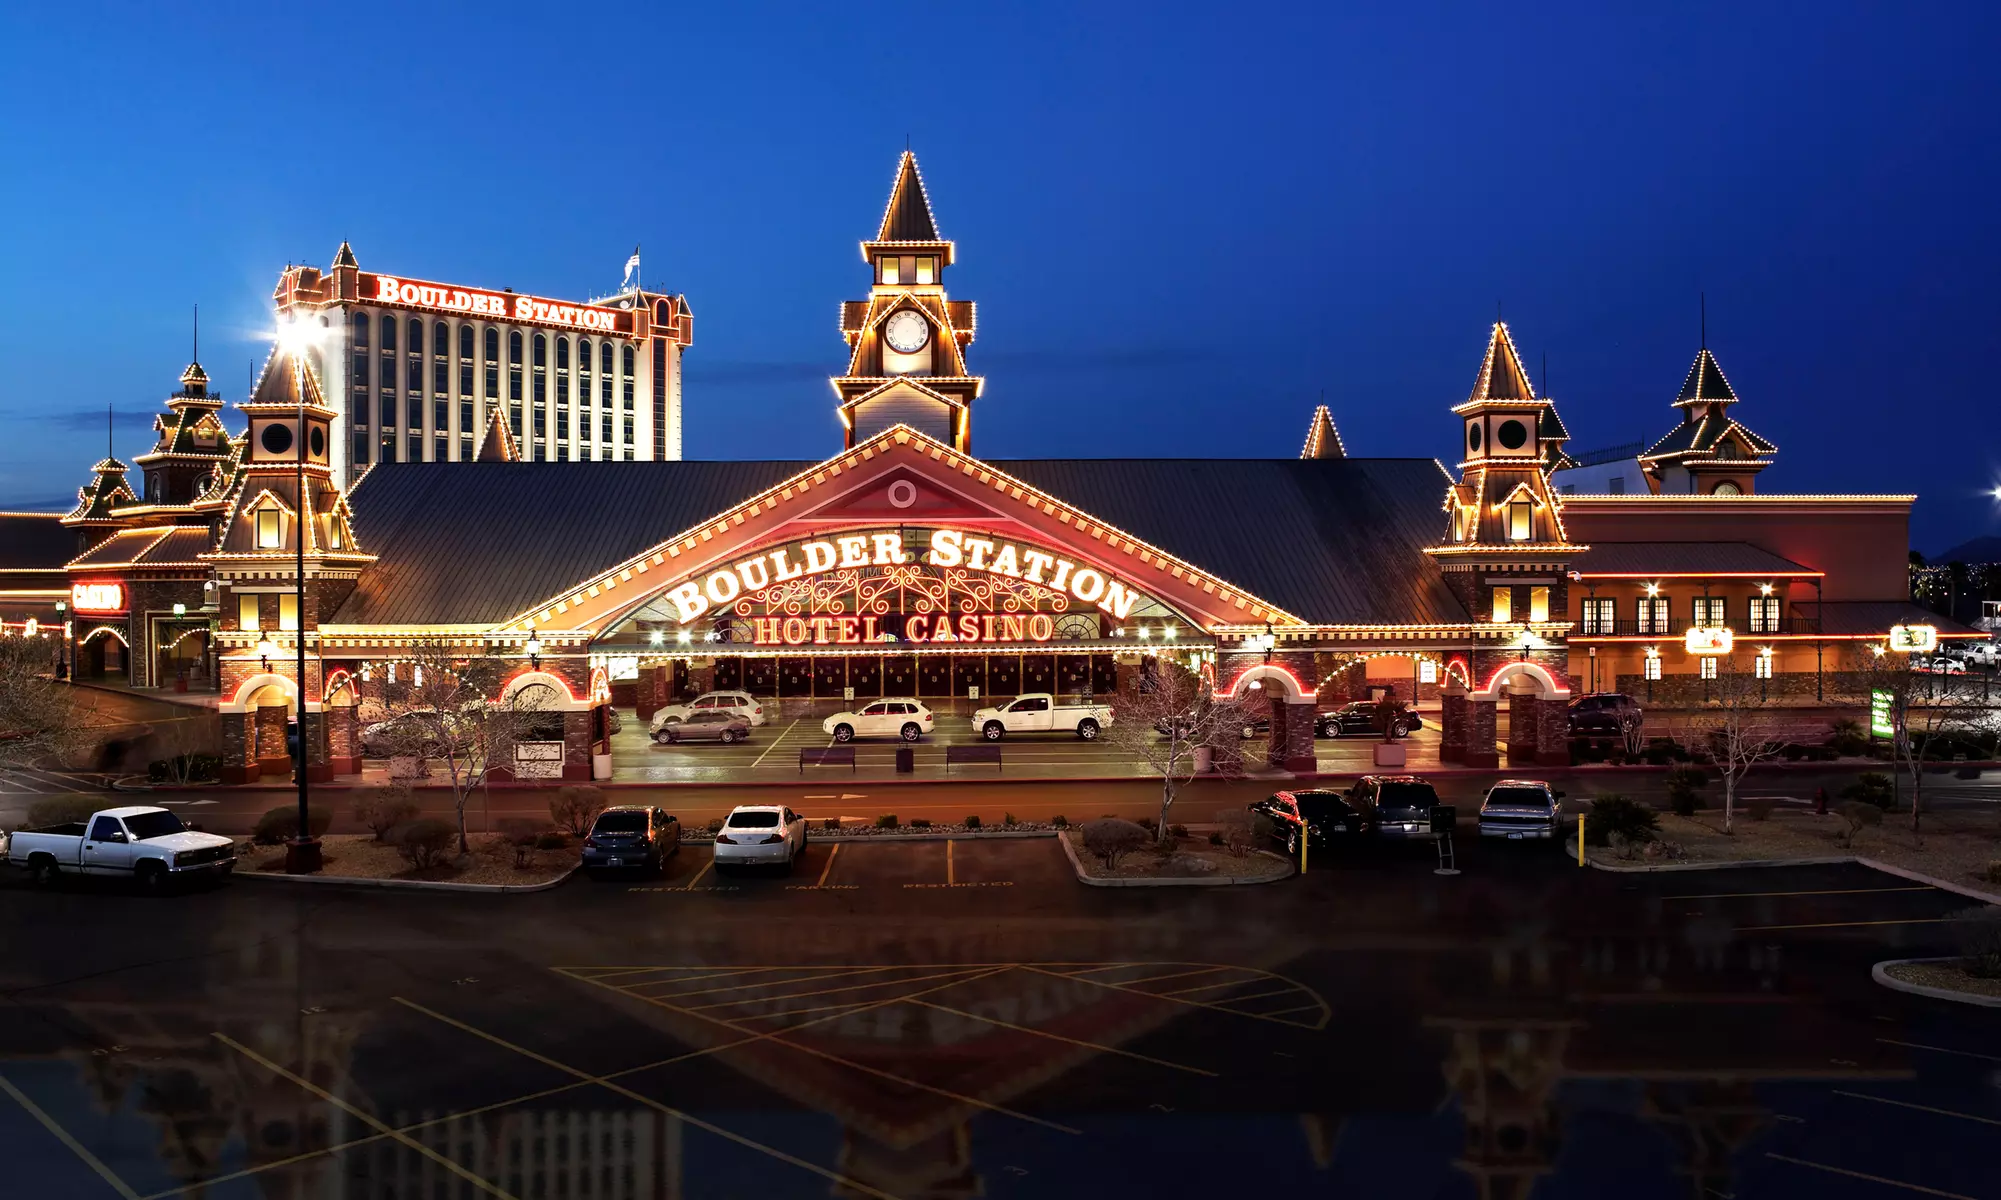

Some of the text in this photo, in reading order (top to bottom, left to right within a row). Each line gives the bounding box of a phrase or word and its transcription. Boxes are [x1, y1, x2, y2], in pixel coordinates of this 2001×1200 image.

[377, 275, 617, 330] BOULDER STATION
[664, 529, 1140, 625] BOULDER STATION
[752, 613, 1055, 645] HOTEL CASINO
[627, 885, 741, 893] RESTRICTED
[902, 880, 1015, 889] RESTRICTED
